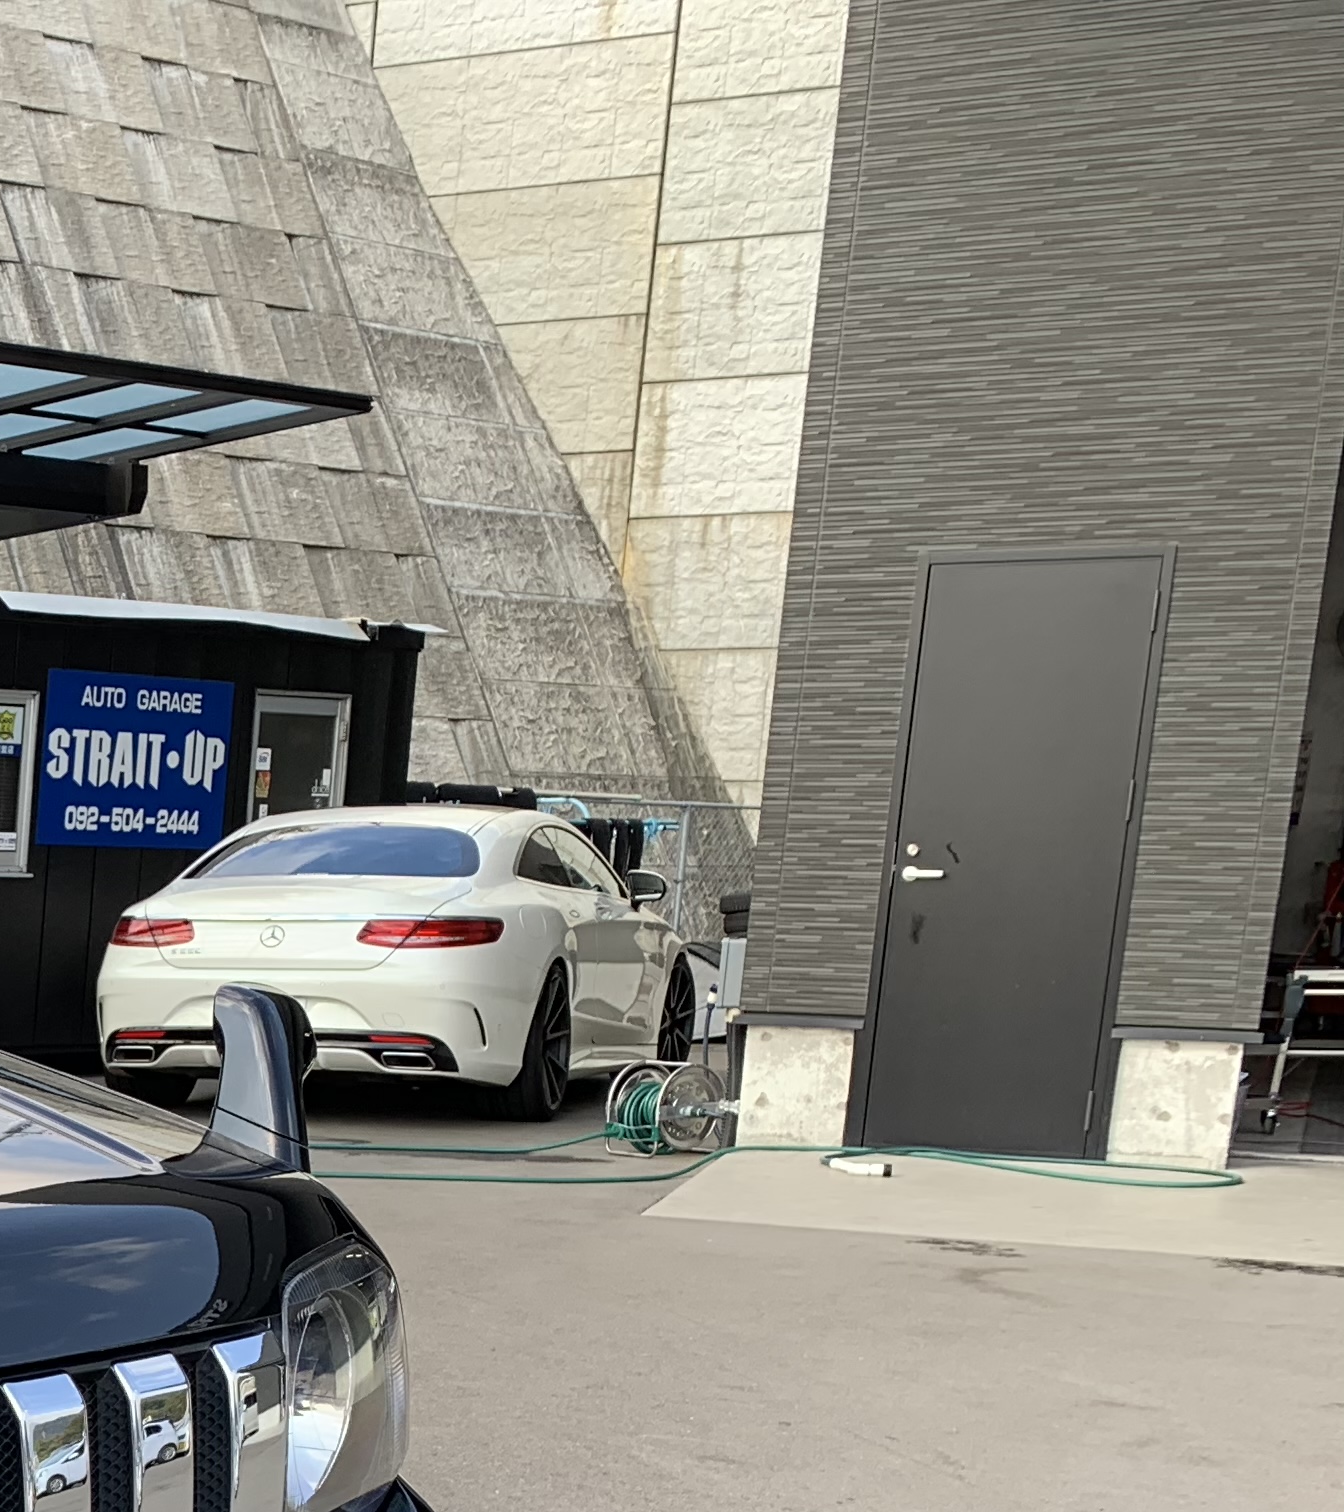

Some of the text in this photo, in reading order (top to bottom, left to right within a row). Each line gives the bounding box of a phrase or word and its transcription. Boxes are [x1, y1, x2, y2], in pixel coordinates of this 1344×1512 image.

[81, 685, 203, 714] AUTO GARAGE
[64, 804, 200, 835] 092-504-2444
